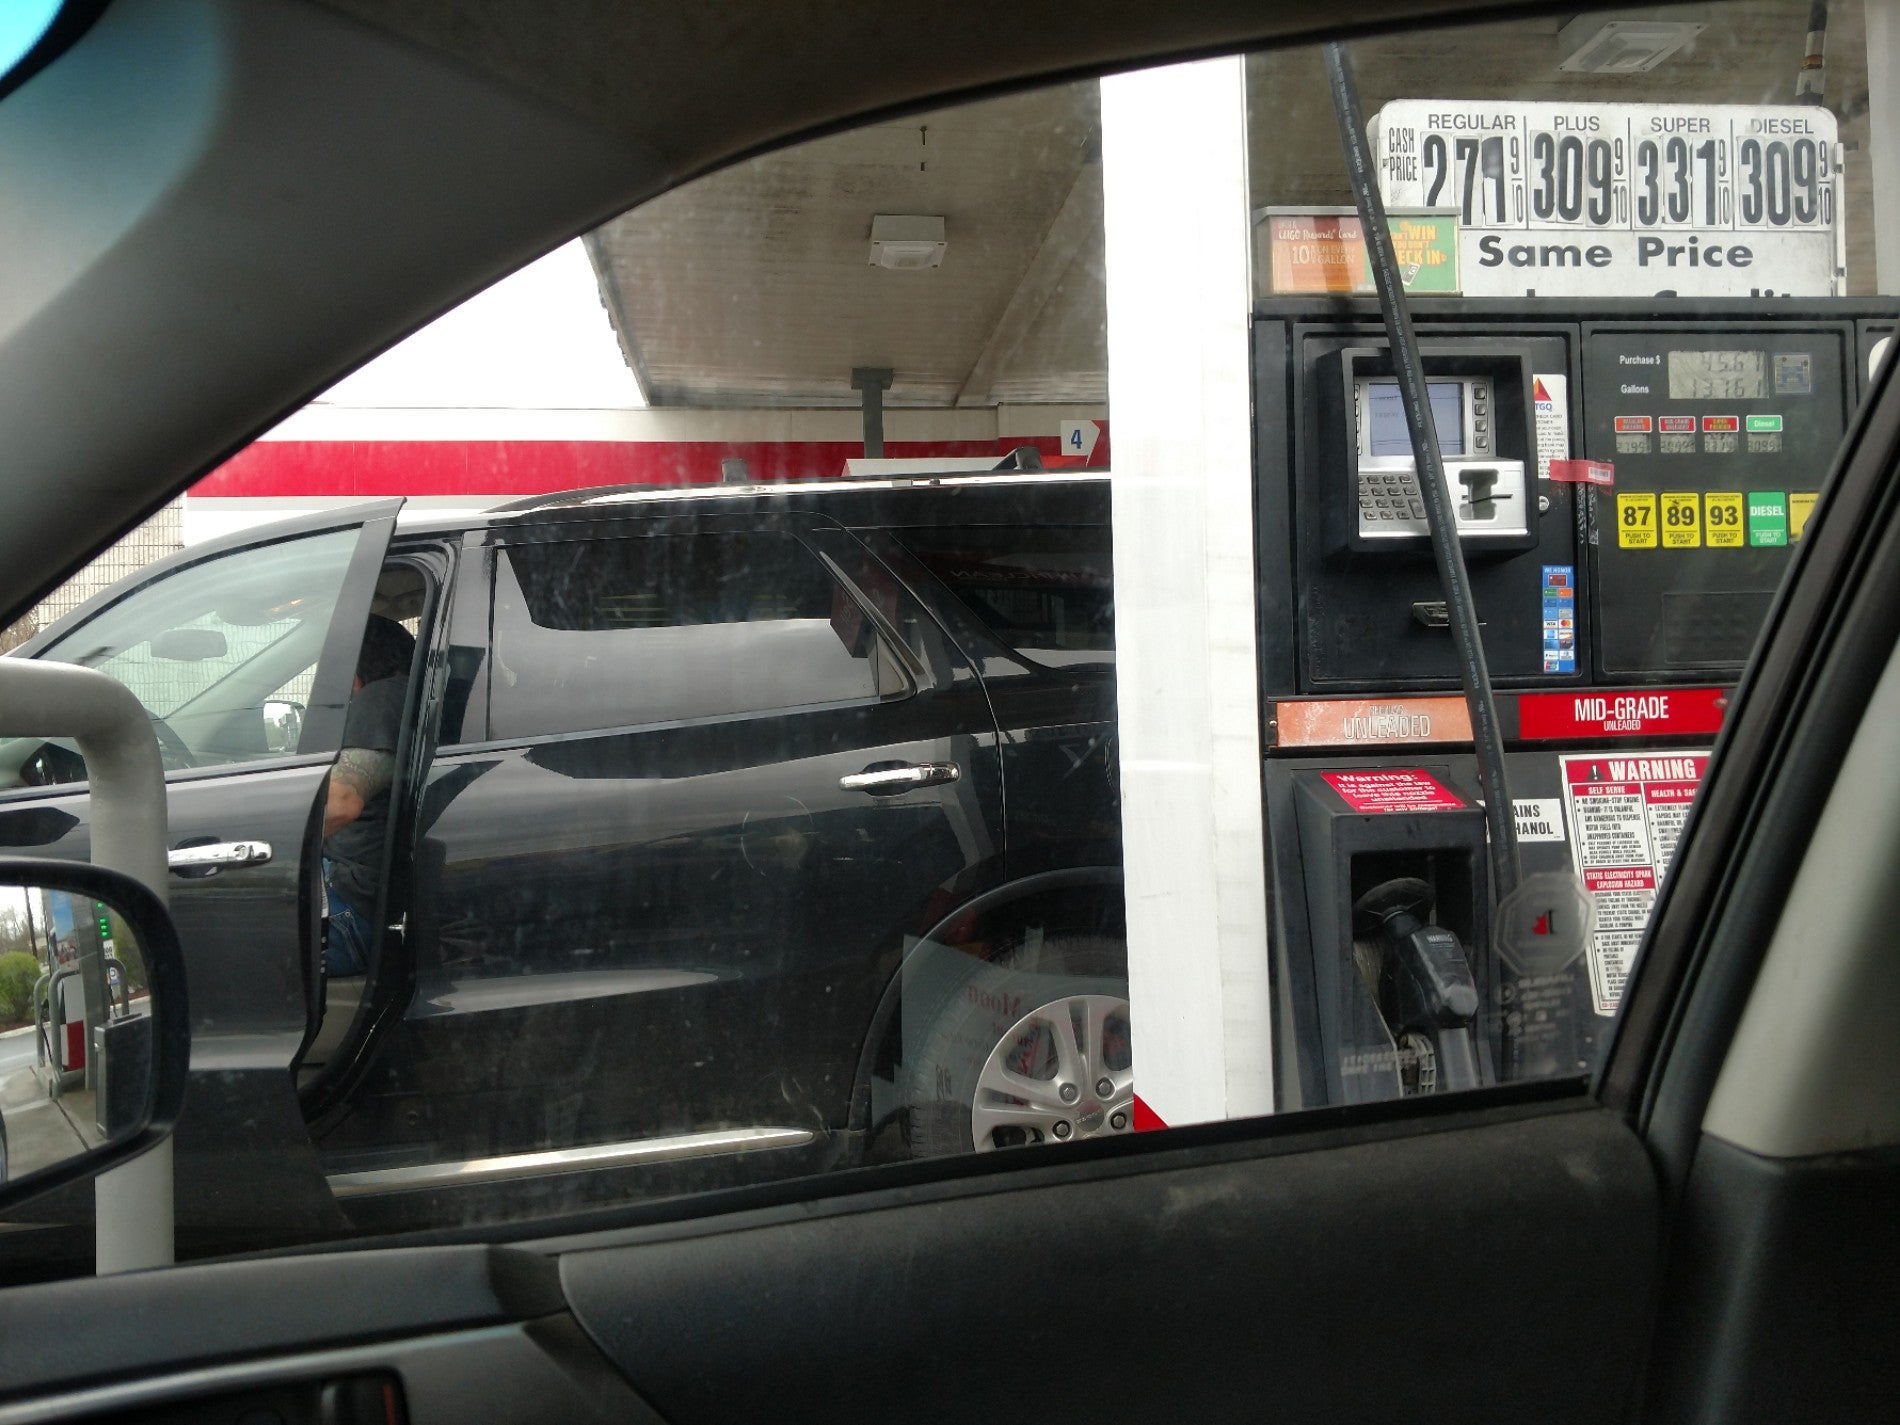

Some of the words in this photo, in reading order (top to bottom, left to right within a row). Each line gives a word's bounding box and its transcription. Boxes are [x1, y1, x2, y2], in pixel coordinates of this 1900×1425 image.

[1428, 114, 1516, 130] REGULAR
[1554, 116, 1600, 131] PLUS
[1651, 117, 1711, 133] SUPER
[1750, 118, 1814, 134] DIESEL
[1389, 127, 1414, 153] CASH
[1390, 156, 1417, 181] PRICE
[1534, 132, 1612, 225] 309
[1638, 137, 1716, 226] 331
[1741, 138, 1818, 226] 309
[1409, 225, 1437, 240] WIN
[1397, 250, 1424, 265] ECK
[1427, 250, 1441, 265] IN
[1479, 235, 1613, 267] Same
[1638, 235, 1754, 267] Price
[1619, 355, 1655, 365] Purchase
[1655, 354, 1661, 365] $
[1620, 384, 1650, 394] Gallons
[1754, 420, 1775, 428] Diesel
[1070, 430, 1083, 449] 4
[1624, 506, 1651, 526] 87
[1667, 506, 1695, 526] 89
[1710, 505, 1739, 526] 93
[1750, 505, 1784, 516] DIESEL
[1574, 696, 1670, 721] MID-GRADE
[1343, 715, 1431, 739] UNLEADED
[1603, 720, 1641, 731] UNLEADED
[1336, 774, 1418, 782] Warning:
[1608, 759, 1697, 781] WARNING
[1588, 787, 1603, 795] SELF
[1606, 786, 1626, 794] SERVE
[1651, 789, 1675, 798] HEALTH
[1684, 788, 1698, 797] SAF
[1513, 804, 1540, 818] AINS
[1516, 822, 1553, 835] HANOL
